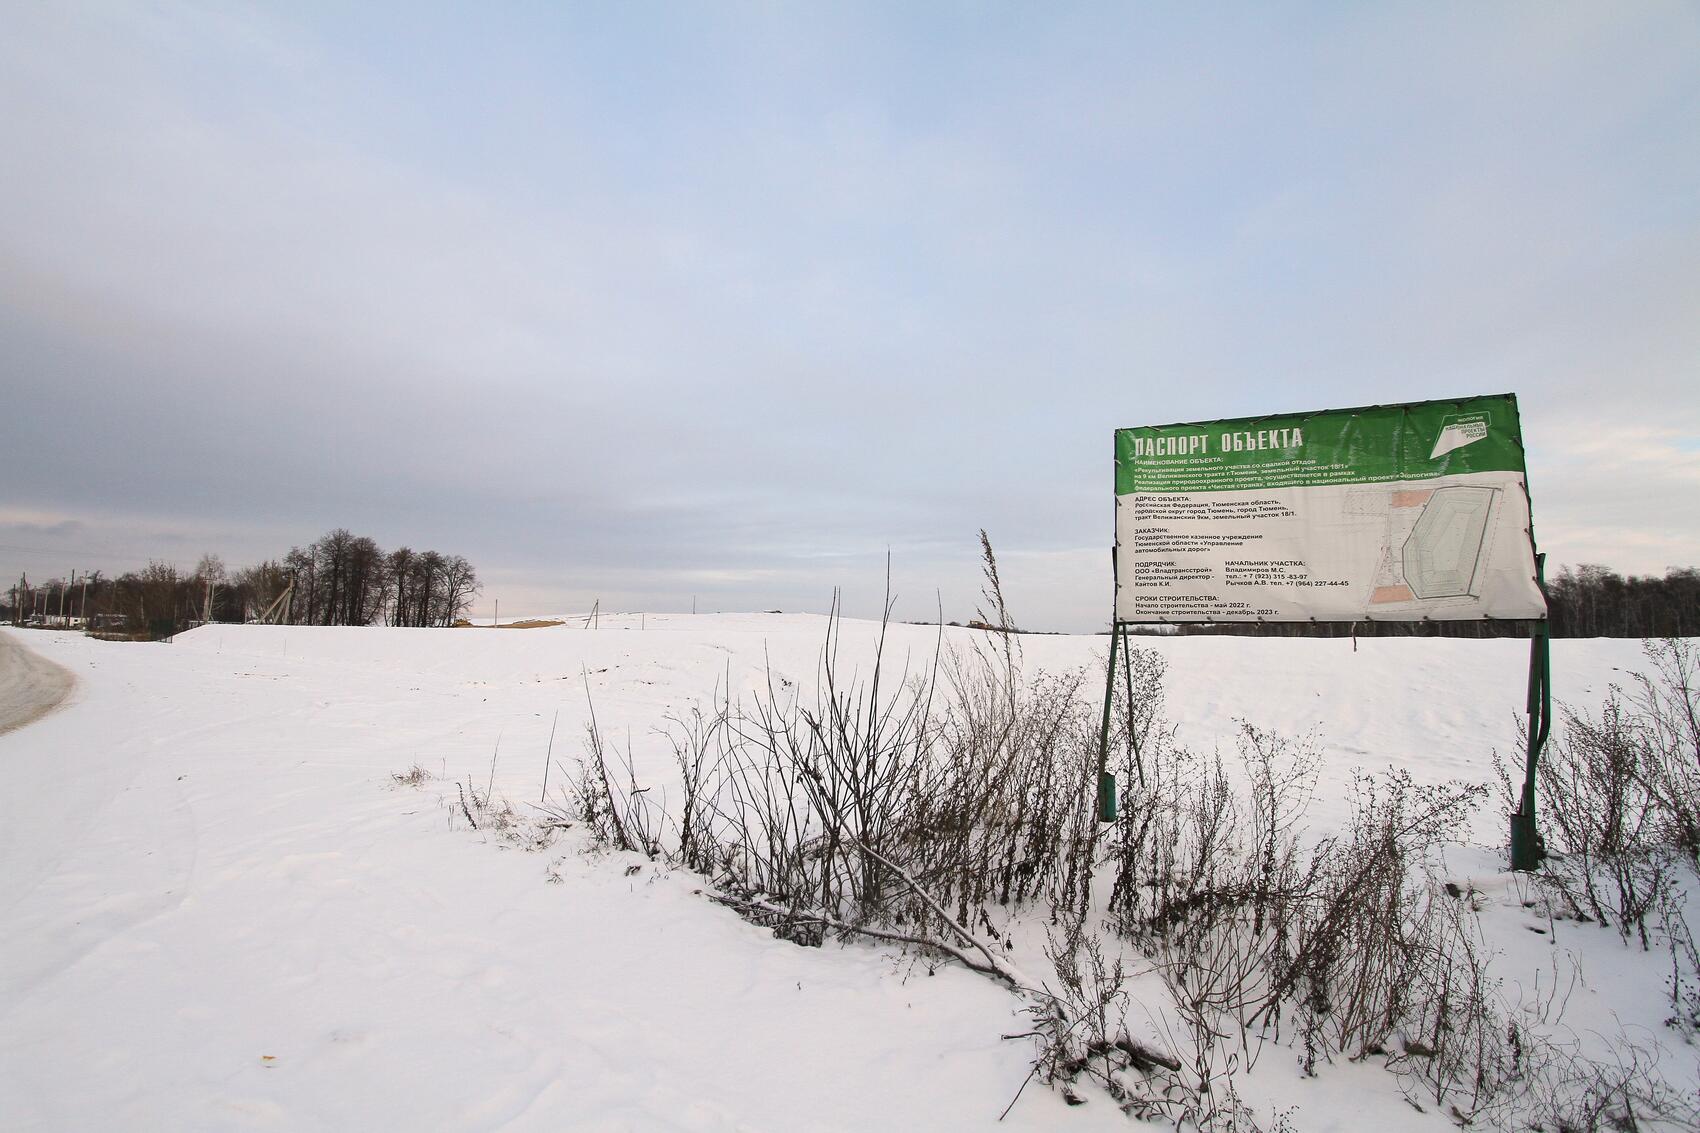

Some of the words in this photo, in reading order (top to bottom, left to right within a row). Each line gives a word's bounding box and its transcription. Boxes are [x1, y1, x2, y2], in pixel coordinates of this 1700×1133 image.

[1135, 435, 1208, 456] ПАСПОРТ
[1222, 428, 1303, 452] ОБЪЕКТА
[1251, 512, 1280, 520] участок
